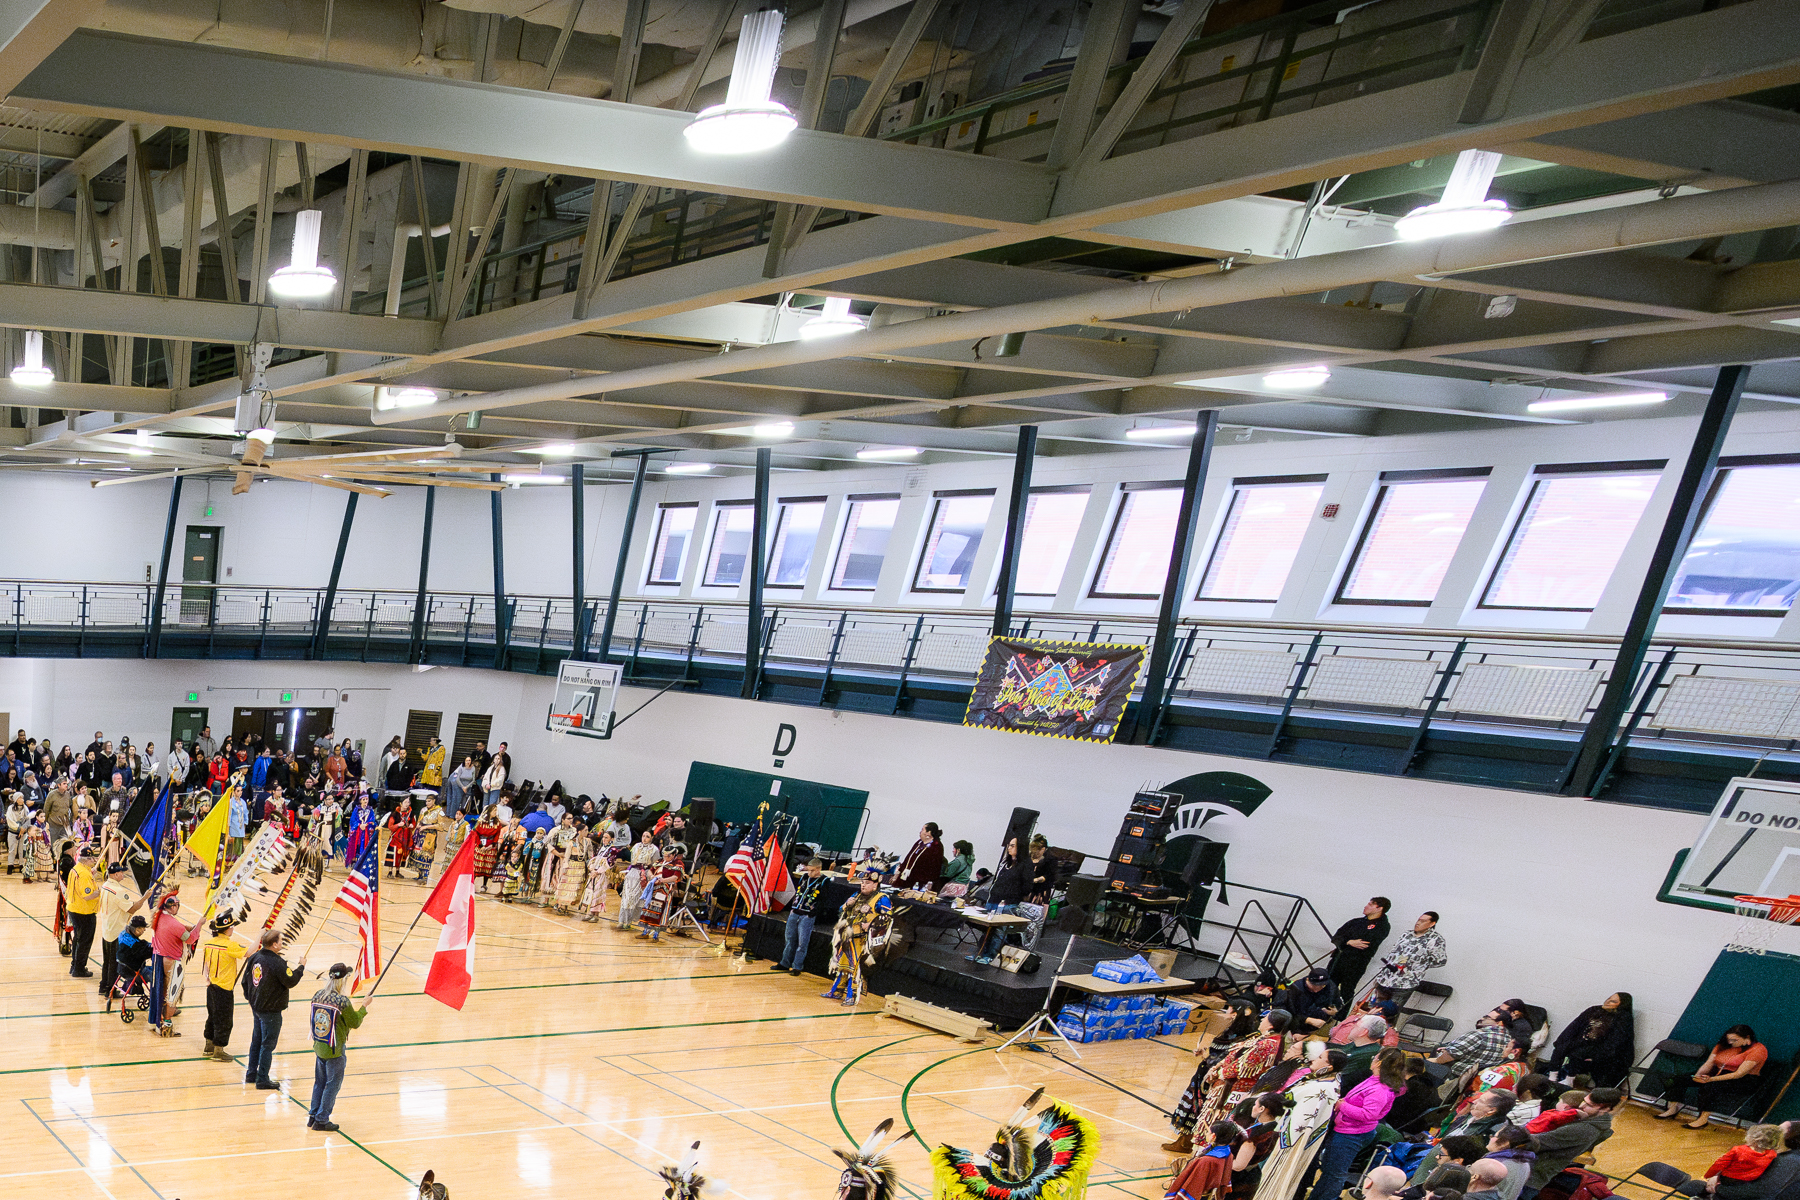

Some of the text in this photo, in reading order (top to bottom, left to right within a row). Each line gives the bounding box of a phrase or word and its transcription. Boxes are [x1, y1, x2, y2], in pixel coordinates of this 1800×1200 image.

[579, 677, 593, 685] HANG
[997, 683, 1096, 715] Pow Wow of Love
[772, 722, 797, 757] D
[1735, 810, 1800, 831] DO NO
[1229, 1092, 1241, 1102] 20
